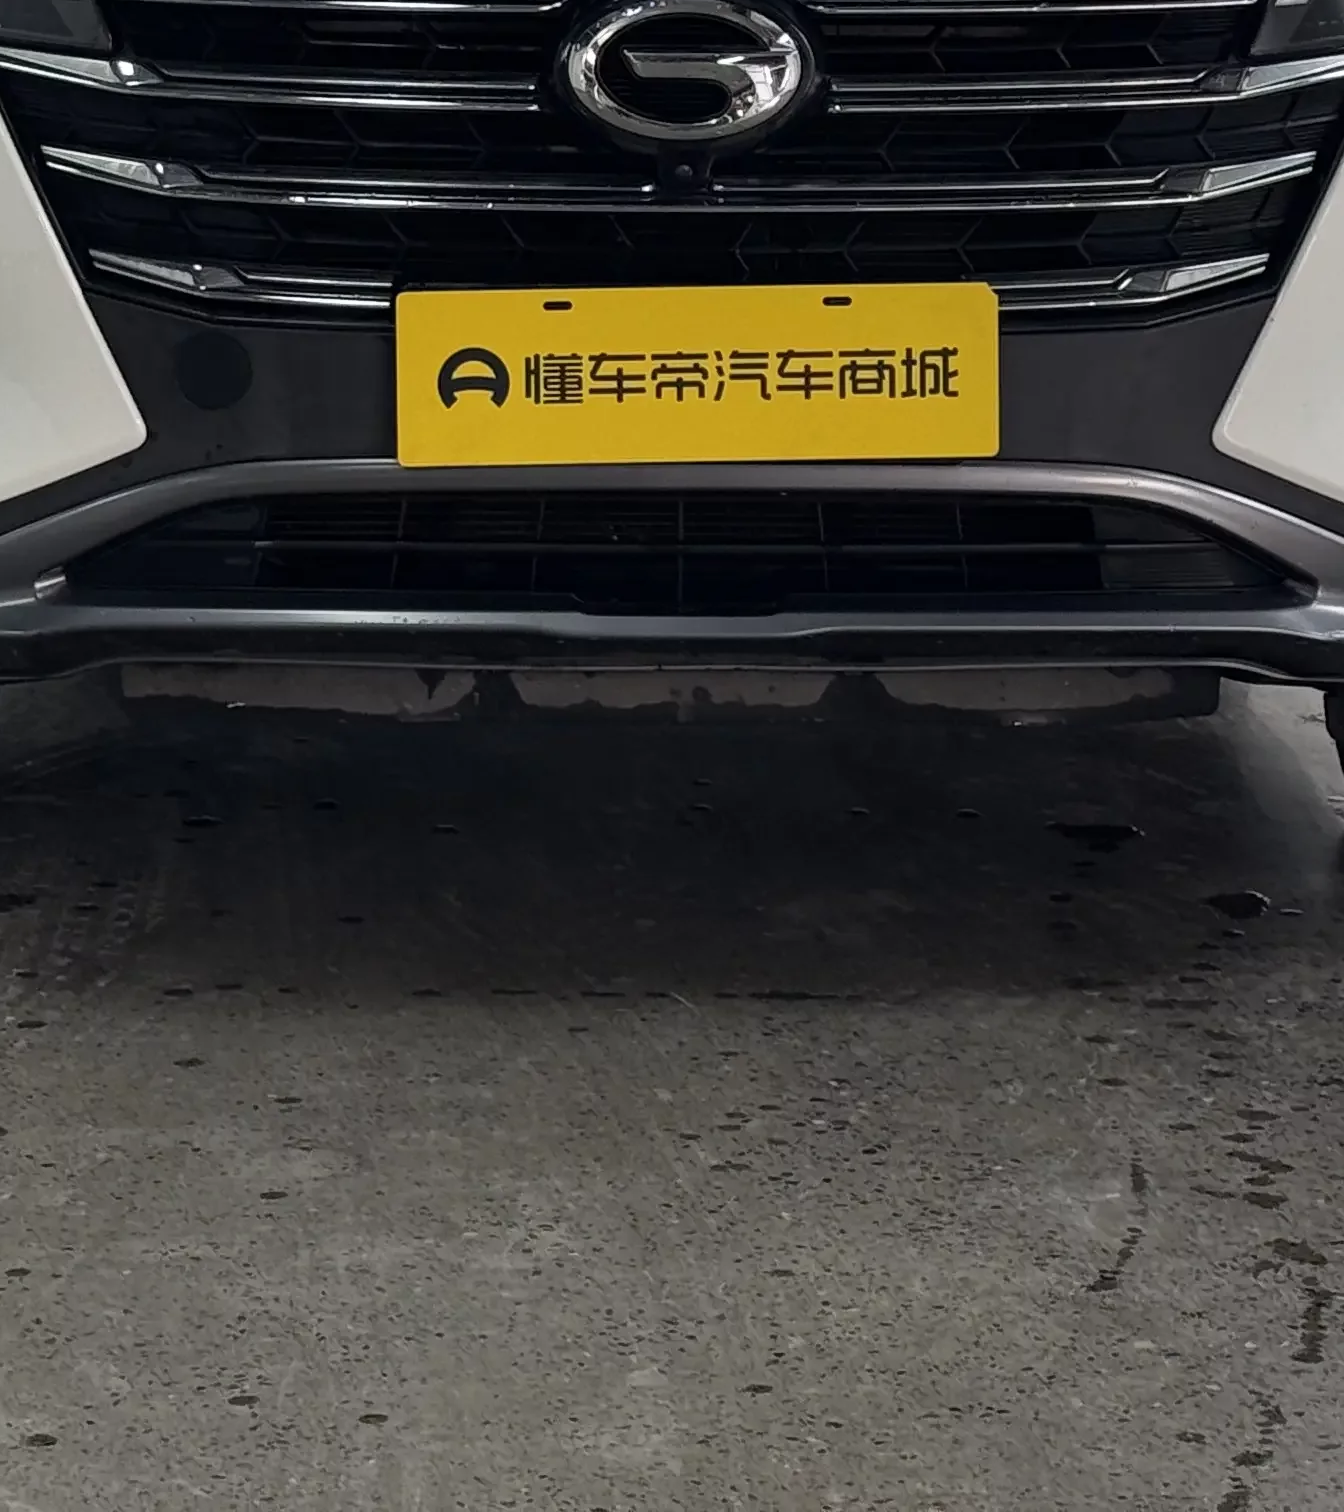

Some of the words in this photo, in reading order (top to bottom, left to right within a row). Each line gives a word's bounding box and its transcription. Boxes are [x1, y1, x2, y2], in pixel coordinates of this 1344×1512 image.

[524, 346, 959, 405] 懂车帝汽车商城
